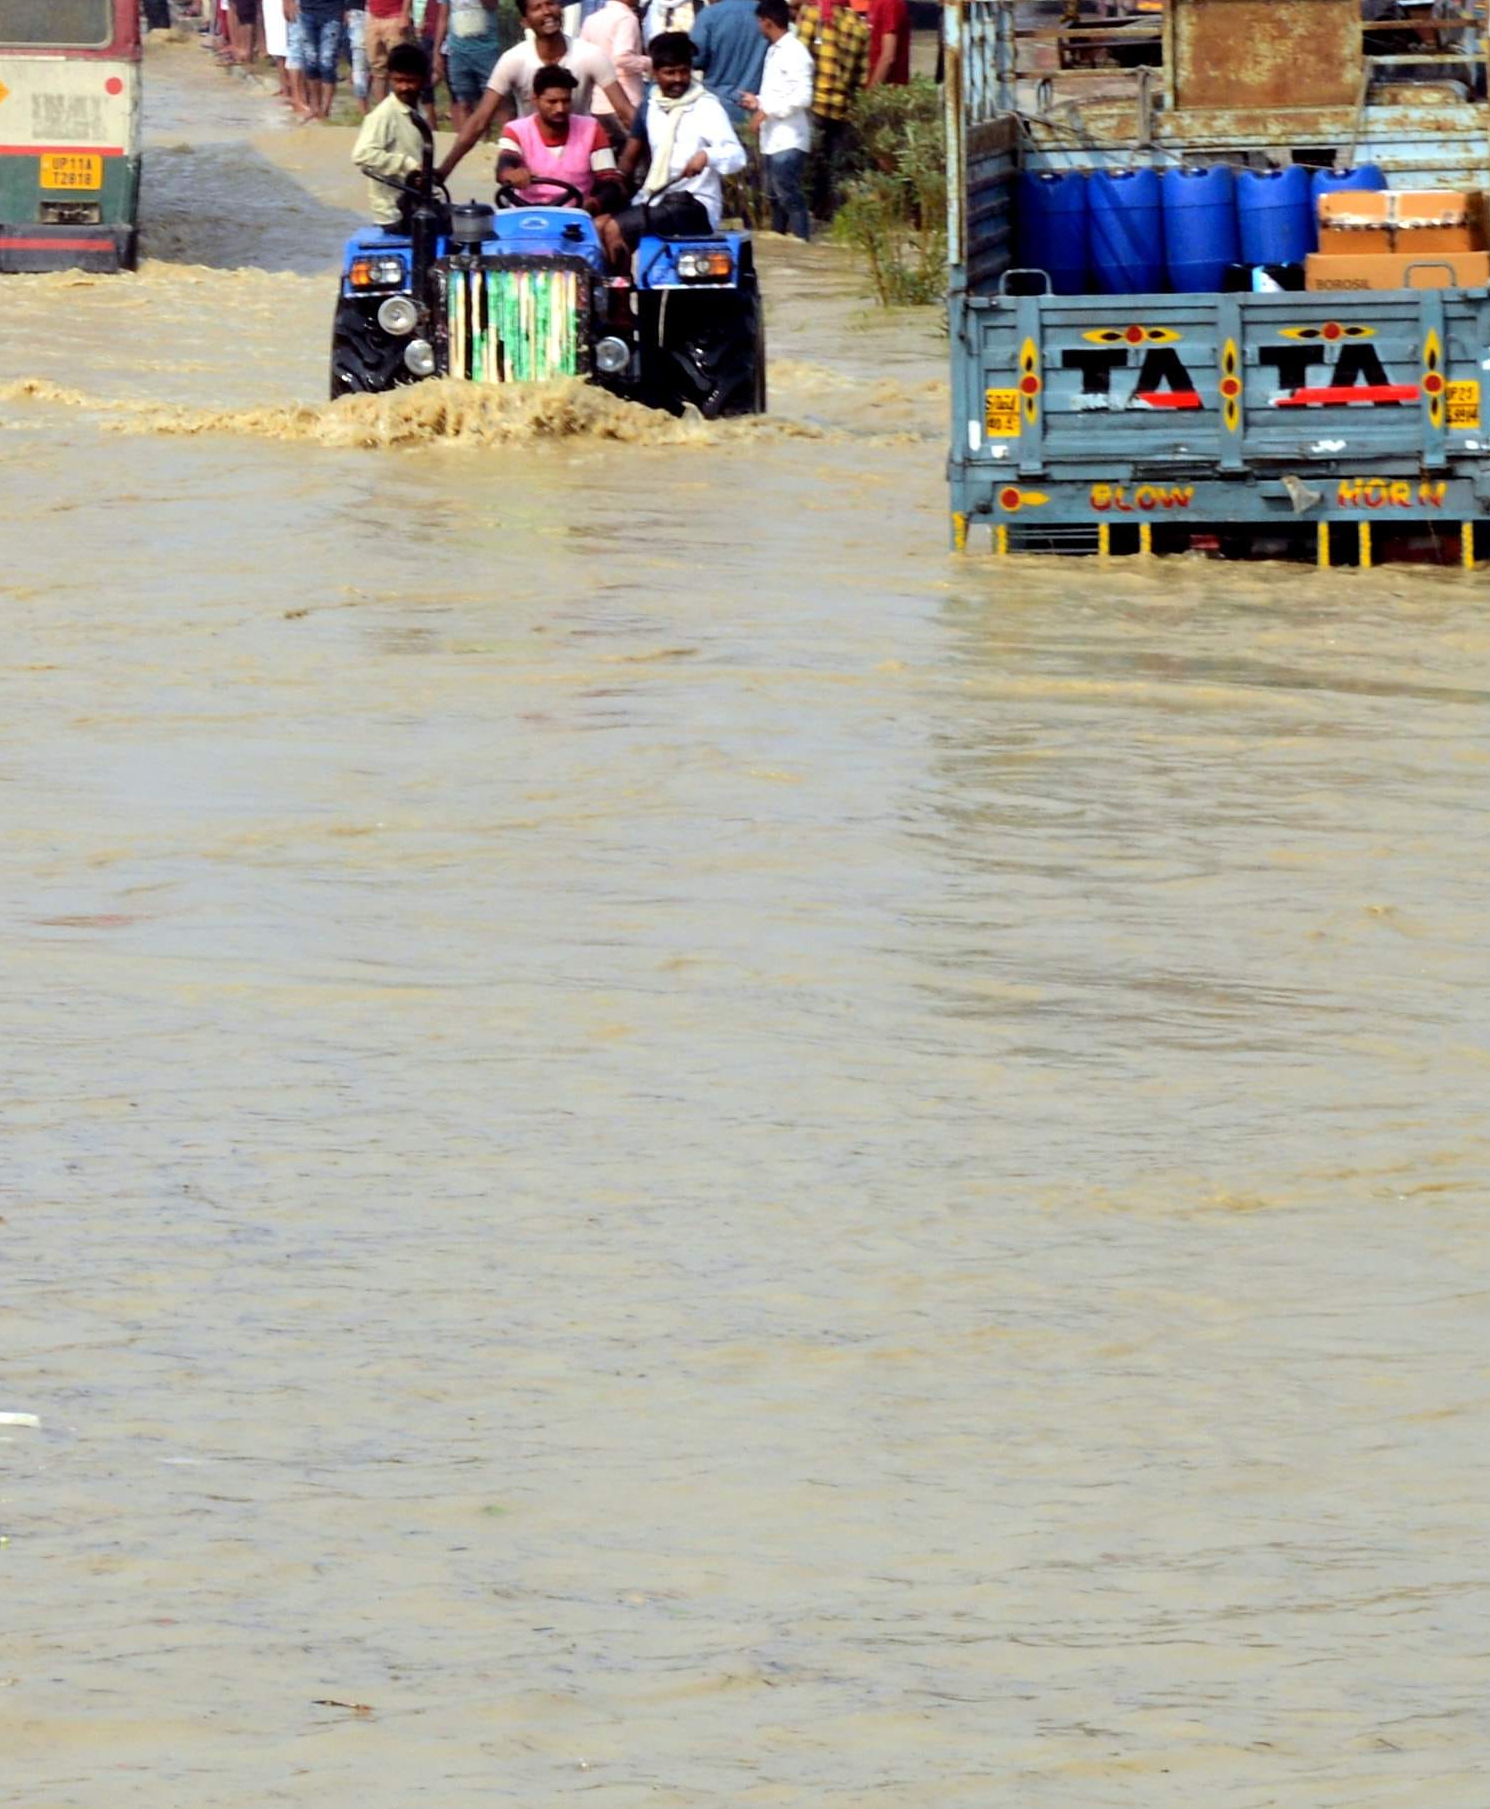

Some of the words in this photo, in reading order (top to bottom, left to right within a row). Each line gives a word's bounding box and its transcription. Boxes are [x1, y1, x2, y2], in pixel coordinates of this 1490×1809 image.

[1315, 278, 1371, 290] BOROSIL
[1089, 482, 1194, 512] BLOW
[1337, 476, 1447, 509] HORN
